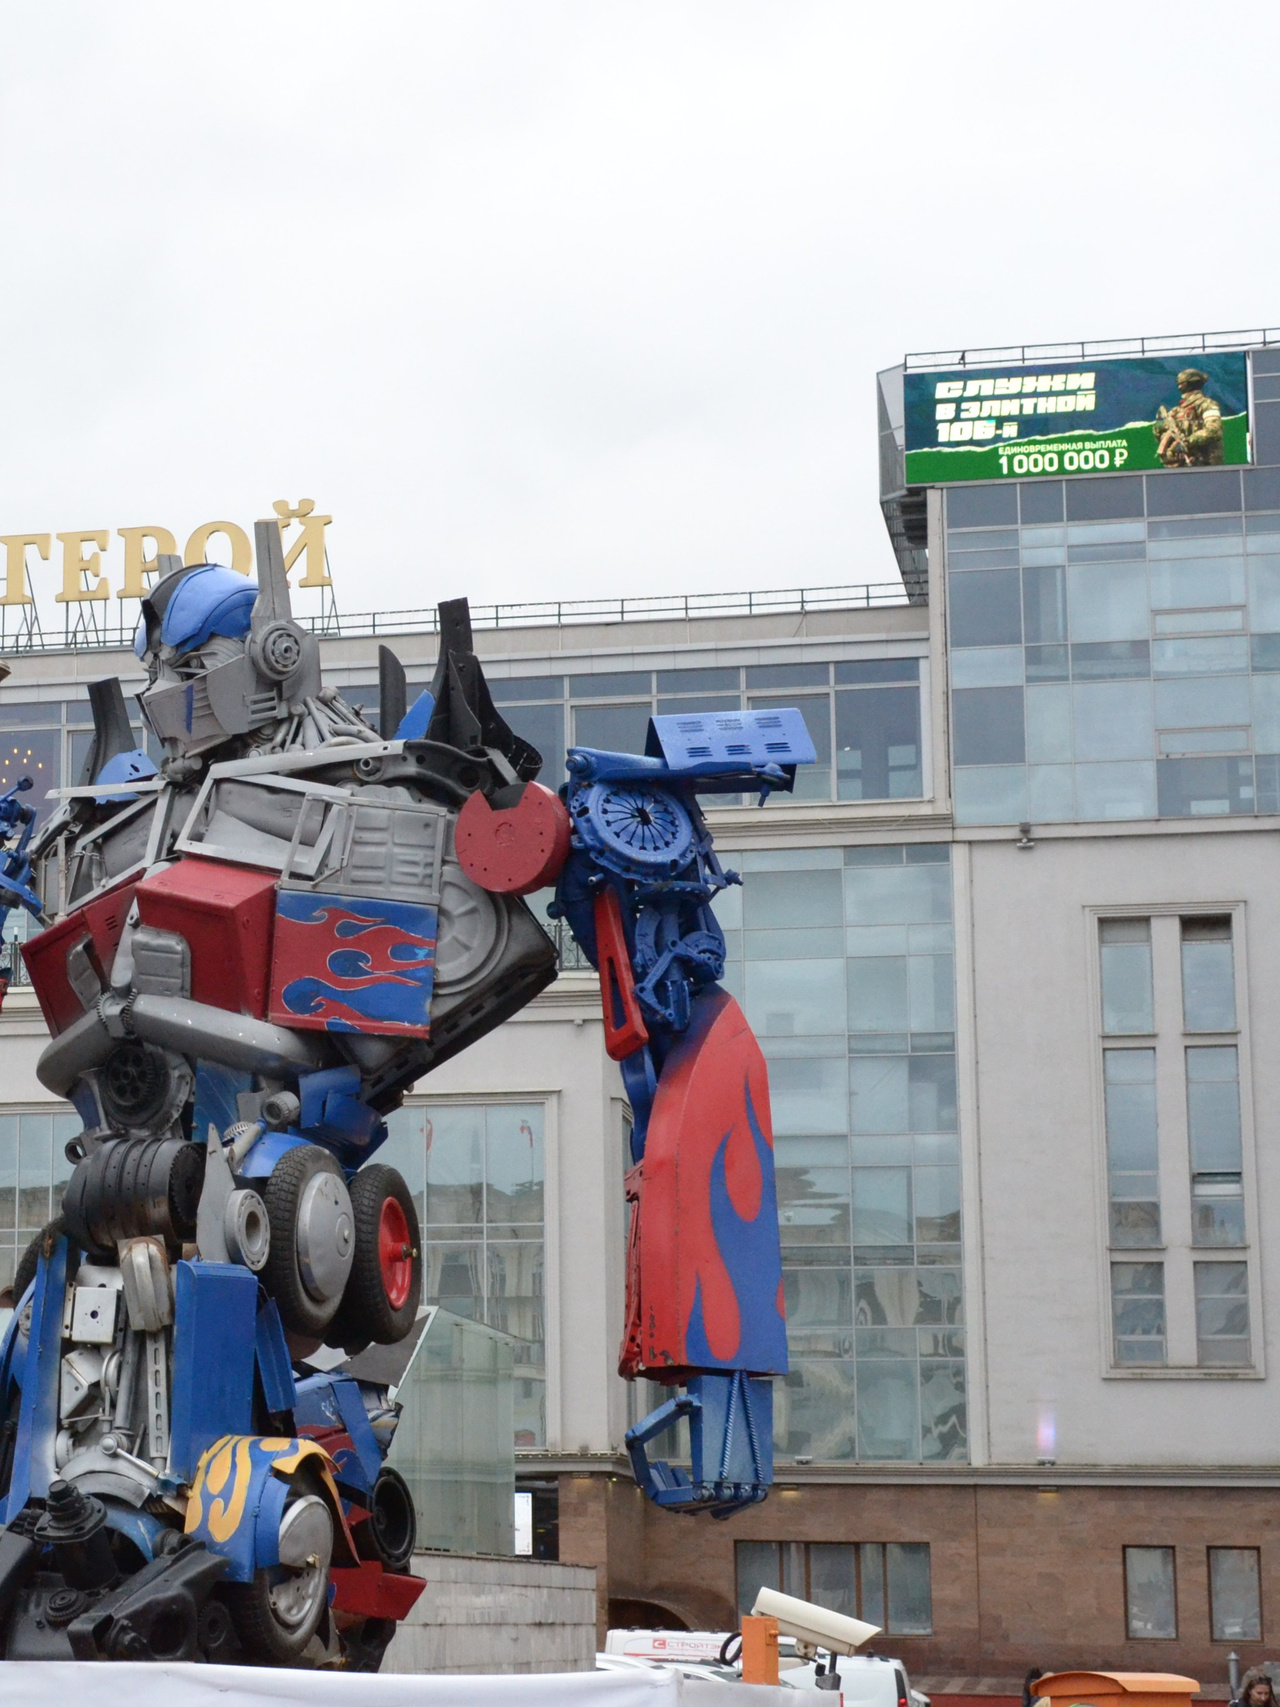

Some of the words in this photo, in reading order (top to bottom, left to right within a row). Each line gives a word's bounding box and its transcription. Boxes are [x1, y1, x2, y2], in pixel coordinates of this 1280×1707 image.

[935, 372, 1096, 399] СЛУЖИ
[935, 402, 957, 420] В
[960, 390, 1096, 419] ЭЛИТНОЙ
[998, 441, 1083, 455] ЕДИНОВРЕМЕННАЯ
[1084, 439, 1128, 450] ВЫПЛАТА
